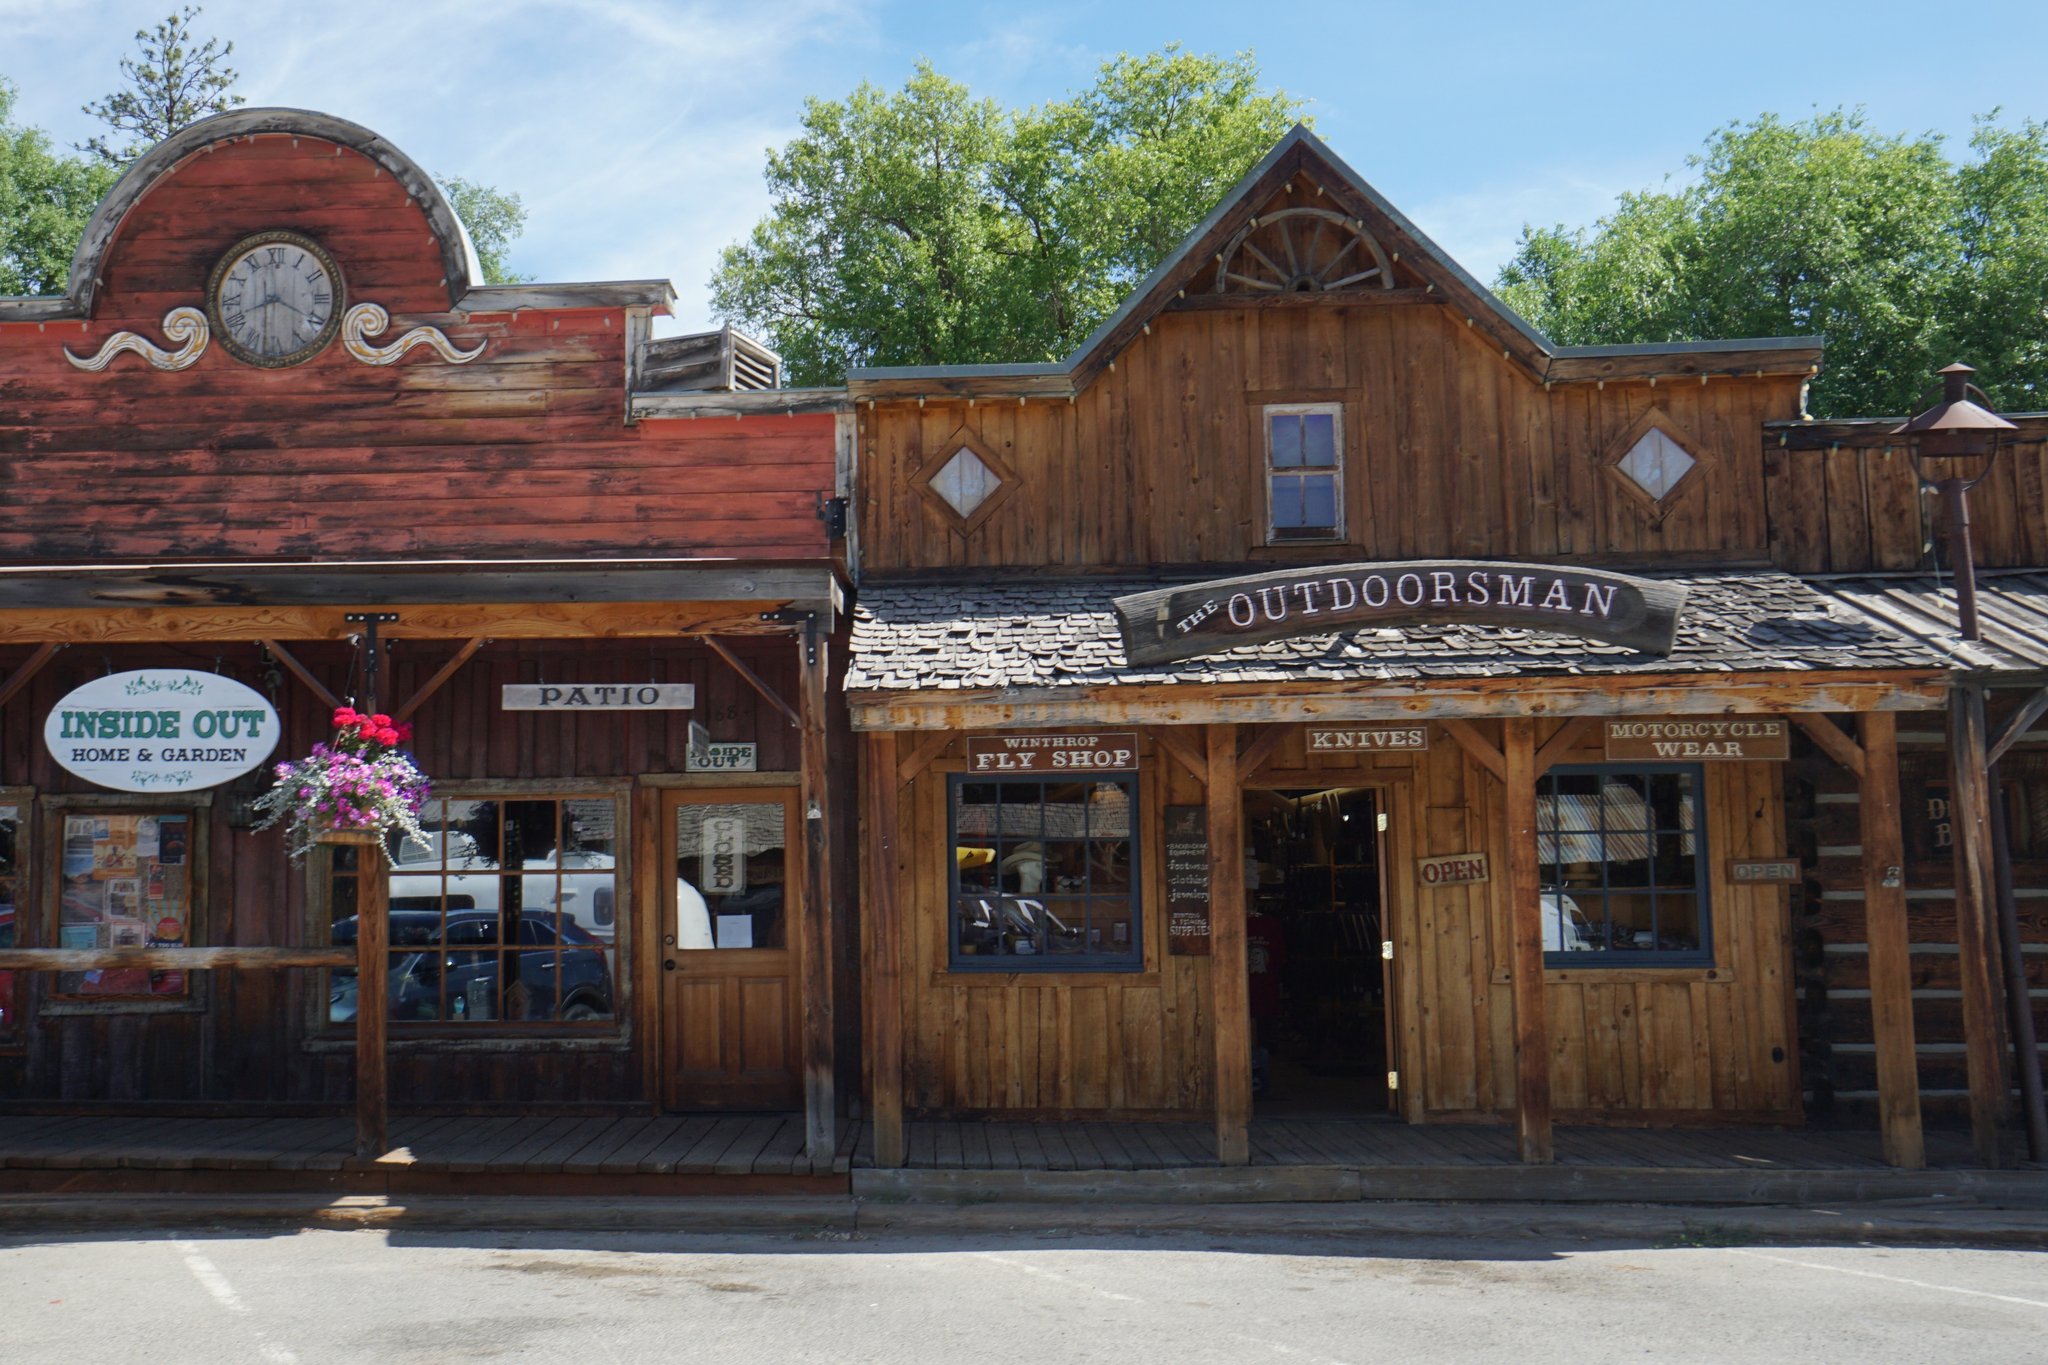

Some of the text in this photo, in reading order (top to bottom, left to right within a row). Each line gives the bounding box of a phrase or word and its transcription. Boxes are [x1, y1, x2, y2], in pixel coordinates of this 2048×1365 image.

[1176, 571, 1617, 633] THE OUTDOORSMAN
[539, 687, 660, 706] PATIO
[60, 710, 266, 739] INSIDE OUT
[1610, 723, 1781, 739] MOTORCYCLE
[1004, 736, 1099, 749] WINTHROP
[1312, 730, 1424, 749] KNIVES
[71, 748, 248, 762] HOME & GARDEN
[1652, 742, 1744, 758] WEAR
[698, 757, 740, 768] OUT
[976, 749, 1131, 770] FLY SHOP
[713, 820, 734, 889] CLOSED
[1422, 858, 1486, 884] OPEN
[1736, 865, 1796, 879] OPEN
[1171, 875, 1208, 887] clothing
